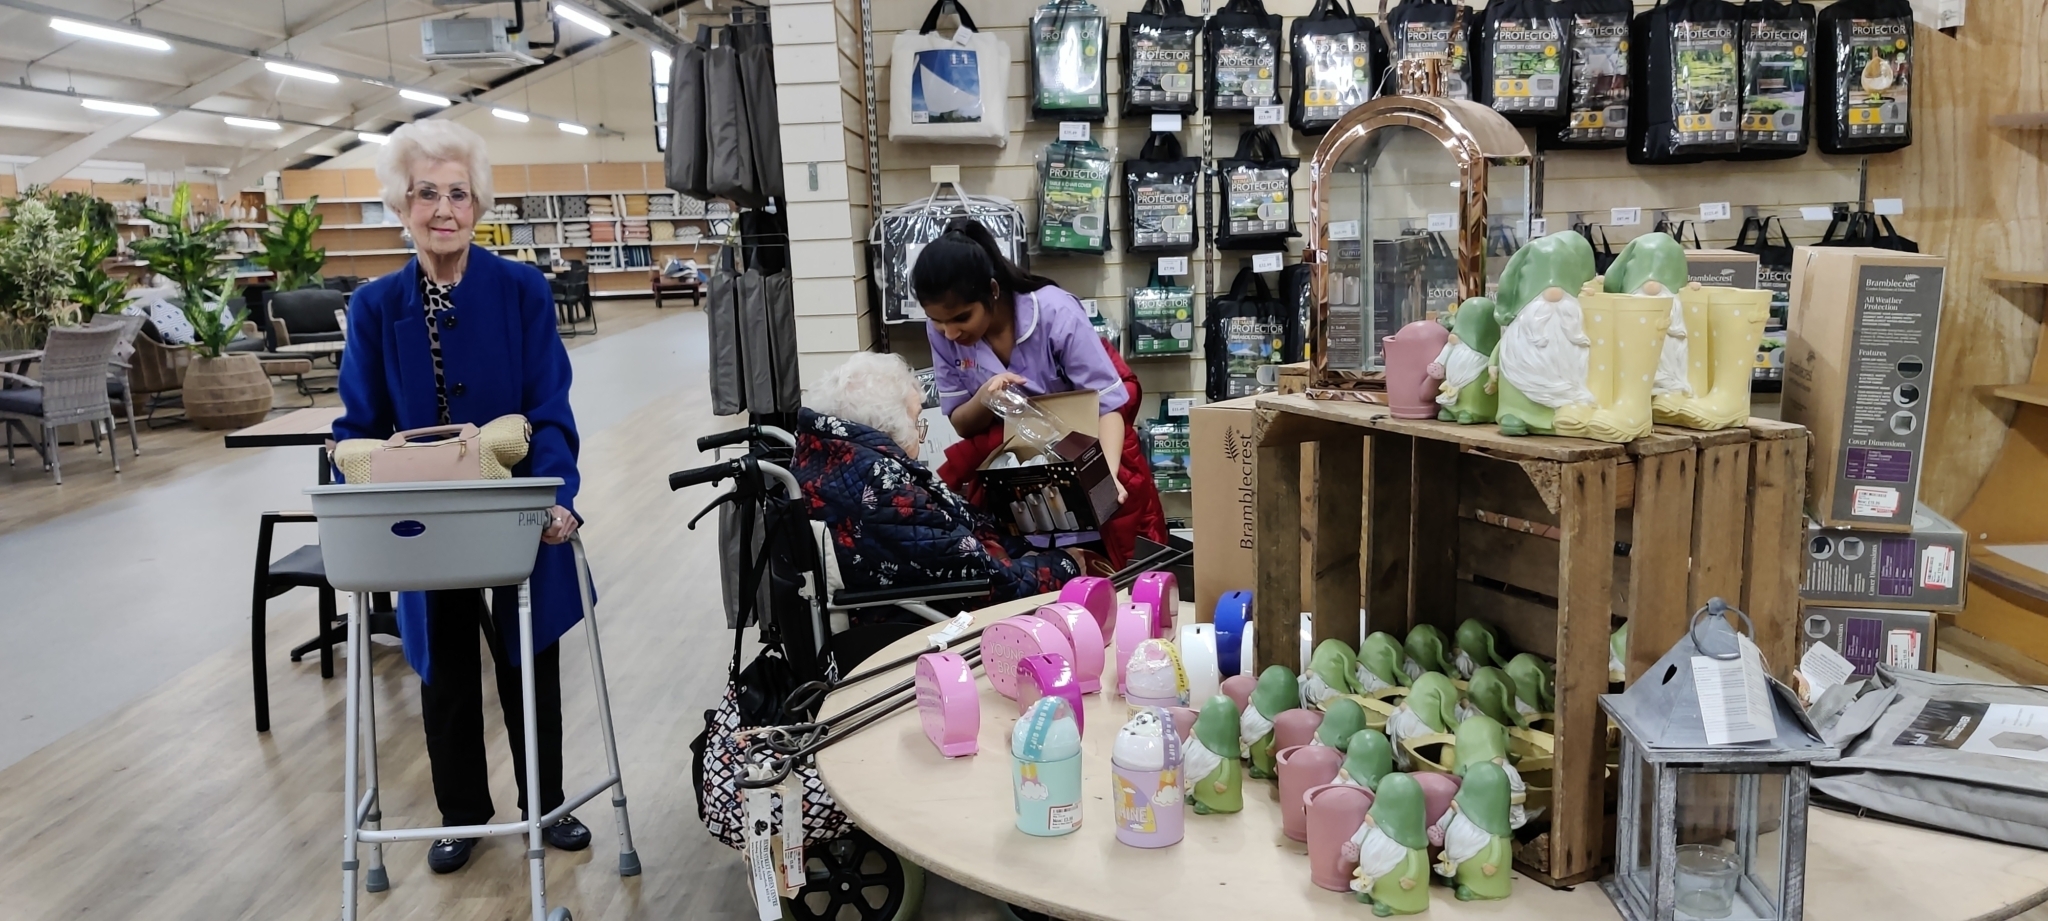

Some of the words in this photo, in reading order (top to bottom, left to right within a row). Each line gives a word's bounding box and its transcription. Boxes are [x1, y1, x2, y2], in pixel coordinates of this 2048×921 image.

[1679, 29, 1732, 39] PROTECTOR
[1750, 30, 1808, 40] PROTECTOR
[1852, 25, 1906, 35] PROTECTOR
[1041, 31, 1095, 40] PROTTOR
[1407, 31, 1464, 41] PROTECTR
[1500, 31, 1558, 41] PROTECTOR
[1136, 51, 1190, 60] PROTECTOR
[1218, 57, 1270, 67] PROTECTOR
[1049, 168, 1104, 180] PROTECTOR
[1231, 181, 1285, 192] PROTECTOR
[1137, 194, 1189, 204] PROTECTOR
[1758, 272, 1791, 281] OTECTO
[1866, 278, 1917, 288] Bramblecrest
[1137, 298, 1188, 308] PROTECTOR
[1863, 303, 1898, 311] Protection
[1231, 324, 1284, 334] PROTECTOR
[1154, 440, 1191, 449] PROTECT
[1848, 438, 1867, 446] Cover
[1868, 439, 1906, 448] Dimensions
[1238, 433, 1253, 549] Bramblecrest
[1869, 544, 1878, 577] Dimensions
[1868, 578, 1877, 596] Cover
[1029, 732, 1039, 749] GIFT
[763, 853, 771, 870] STREET
[766, 870, 775, 889] GARDEN
[770, 889, 779, 907] CENTRE
